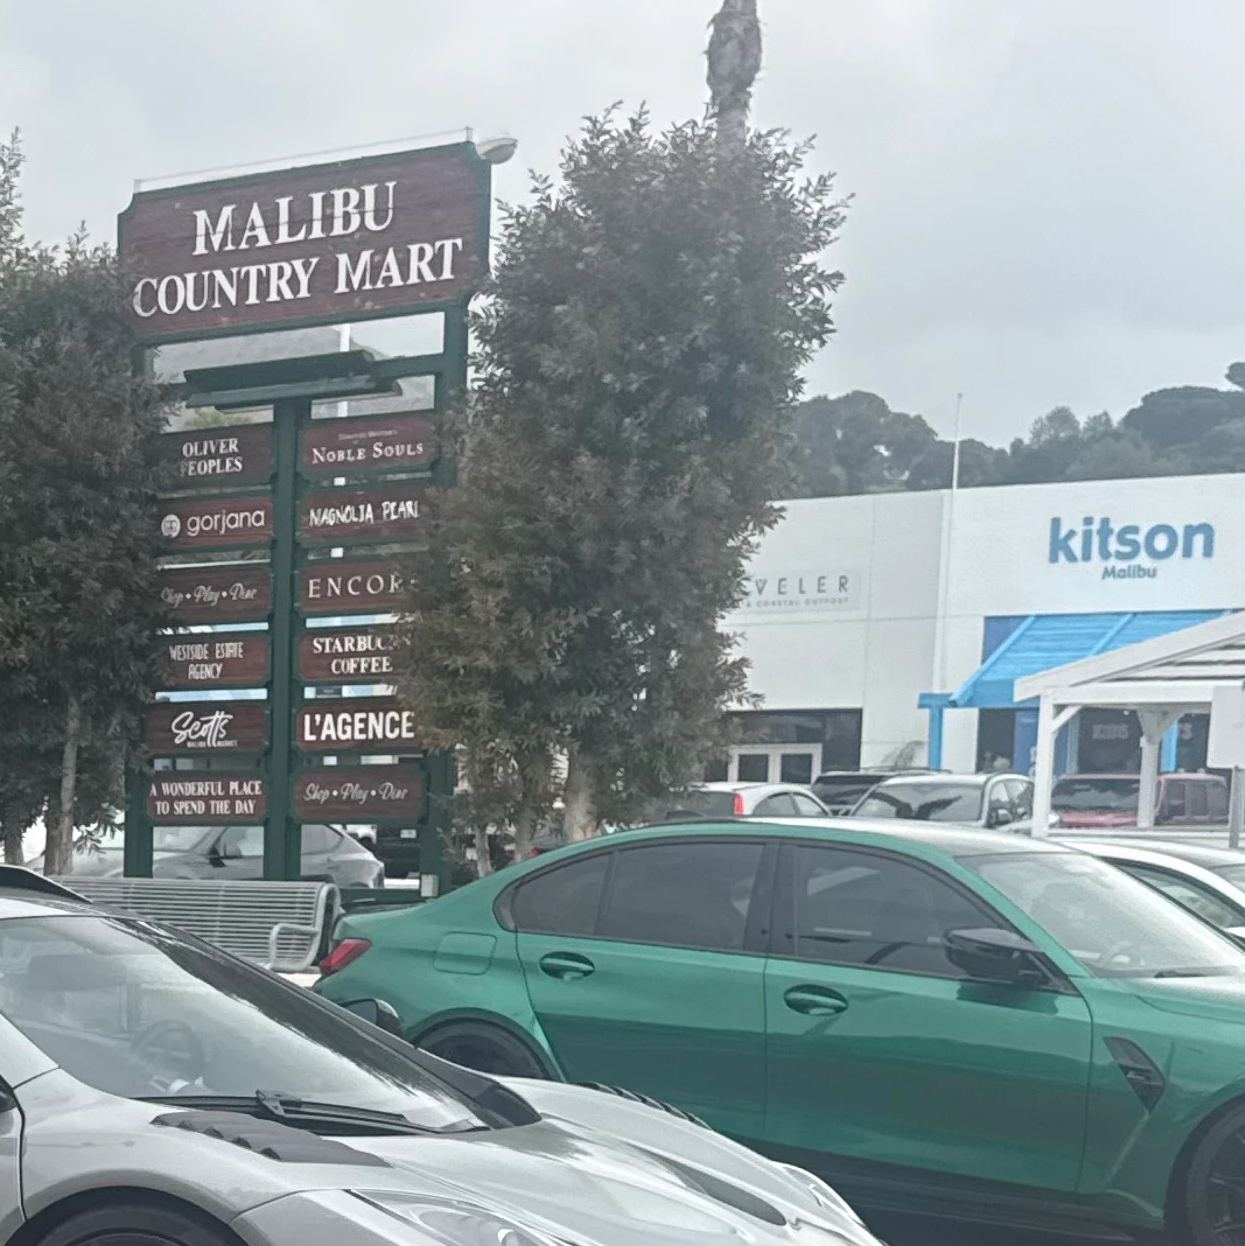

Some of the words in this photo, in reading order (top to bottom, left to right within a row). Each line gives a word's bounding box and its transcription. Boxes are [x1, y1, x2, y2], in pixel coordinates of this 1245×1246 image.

[192, 181, 398, 256] MALIBU
[132, 256, 320, 318] COUNTRY
[333, 238, 463, 295] MART
[182, 438, 239, 458] OLIVER
[180, 456, 243, 477] PEOPLES
[187, 509, 265, 537] gorjana
[309, 503, 374, 527] MAGNOLIA
[382, 500, 420, 520] PEARL
[1048, 516, 1215, 564] kitson
[1101, 564, 1158, 580] Malibu
[755, 575, 849, 595] VELER
[193, 585, 221, 607] Play
[169, 643, 209, 661] WESTSIDE
[215, 641, 244, 659] ESTATE
[188, 663, 223, 680] AGENCY
[331, 656, 394, 675] COFFEE
[303, 711, 415, 741] L'AGENCE
[150, 783, 157, 797] A
[161, 782, 225, 797] WONDERFUL
[229, 780, 262, 796] PLACE
[303, 782, 331, 805] Shop
[340, 782, 370, 805] Play
[155, 801, 170, 816] TO
[174, 800, 205, 816] SPEND
[210, 799, 231, 815] THE
[235, 799, 256, 814] DAY
